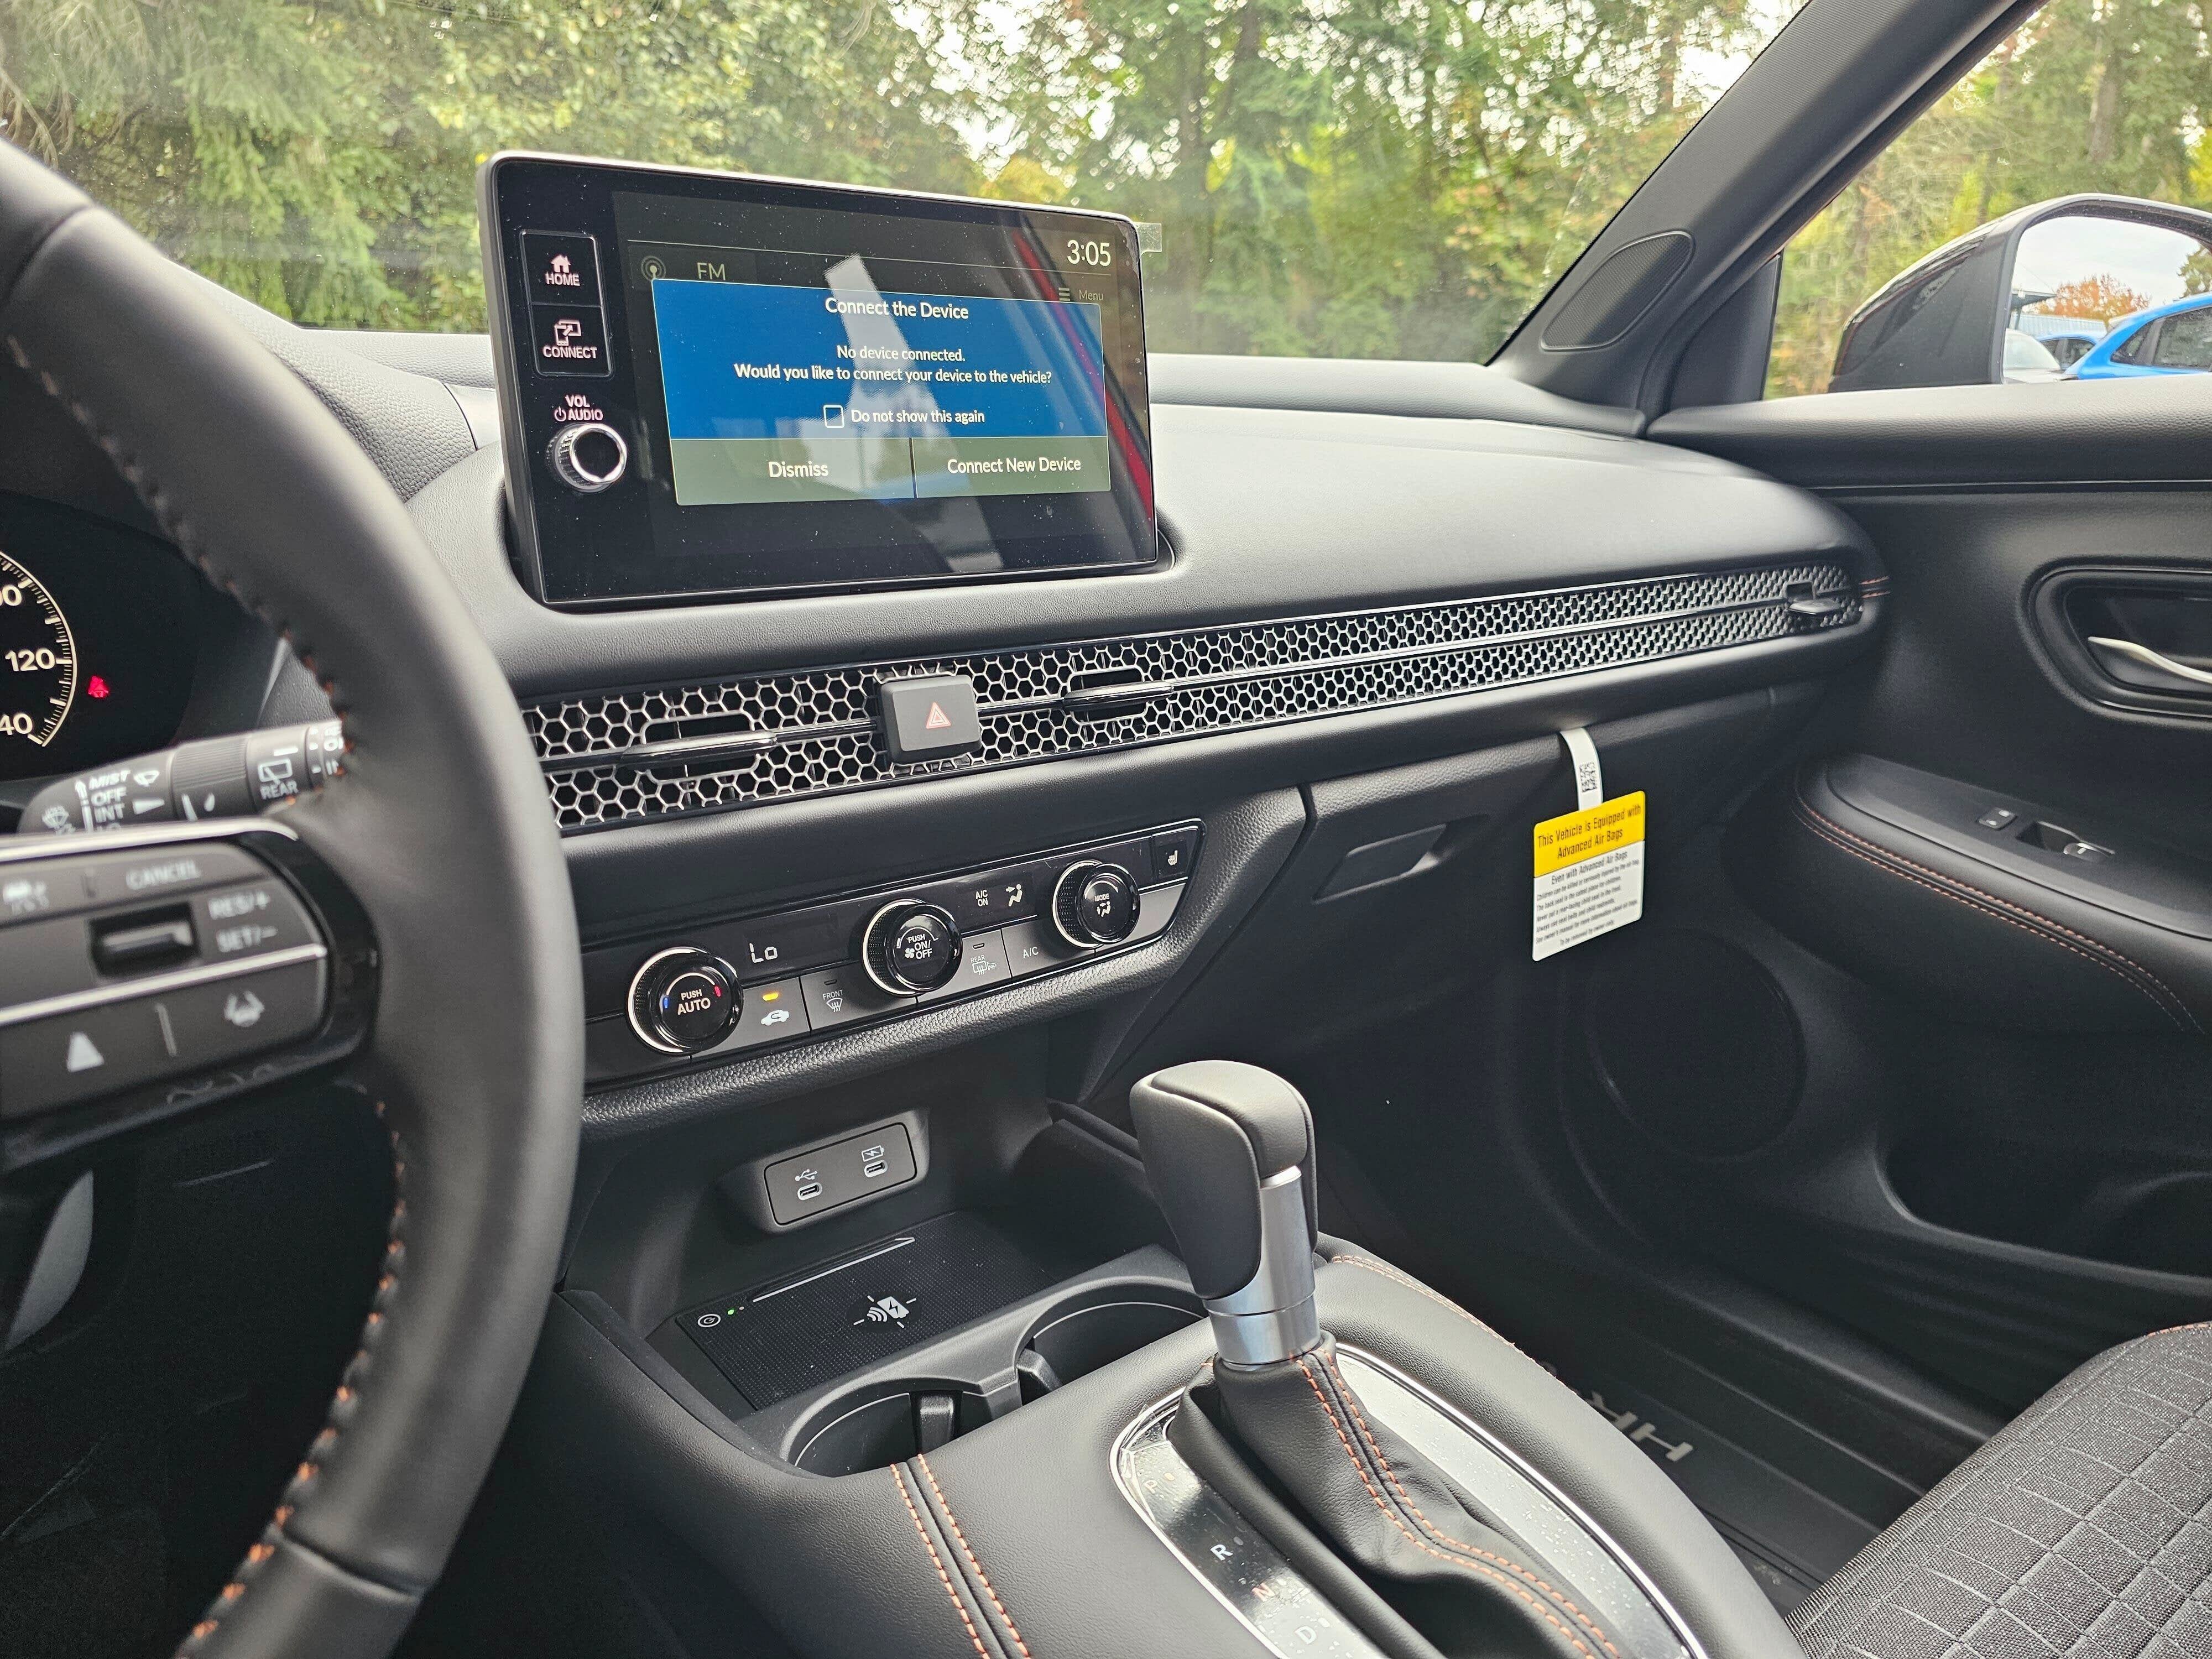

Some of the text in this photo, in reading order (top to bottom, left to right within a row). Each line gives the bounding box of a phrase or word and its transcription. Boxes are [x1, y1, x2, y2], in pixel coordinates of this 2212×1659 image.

[1067, 239, 1112, 267] 3:05
[697, 262, 727, 280] FM
[545, 273, 580, 287] HOME
[1079, 290, 1104, 301] Menu
[825, 298, 969, 319] Connect the Device
[543, 346, 598, 359] CONNECT
[837, 345, 966, 362] No device connected.
[733, 363, 1052, 384] Would you like to connect your device to the vehicle?
[565, 395, 591, 408] VOL
[568, 408, 603, 421] AUDIO
[851, 409, 985, 425] Do not show this again
[768, 460, 829, 478] Dismiss
[947, 456, 1082, 474] Connect New Device
[4, 648, 55, 672] 120
[91, 786, 127, 807] OFF
[259, 780, 299, 800] REAR
[93, 803, 126, 823] INT
[1537, 804, 1641, 848] This Vehicle is Equipped with
[1557, 828, 1623, 859] Advanced Air Bags
[126, 860, 201, 890] CANCEL
[1551, 873, 1565, 885] Even
[1566, 869, 1578, 879] with
[1579, 859, 1605, 874] Advanced
[1615, 852, 1628, 862] Bags
[975, 889, 988, 900] A/C
[977, 898, 989, 907] ON
[1094, 893, 1110, 902] MODE
[907, 933, 926, 943] PUSH
[914, 940, 931, 951] ON/
[749, 942, 778, 964] Lo
[915, 948, 933, 959] OFF
[970, 954, 986, 963] REAR
[1022, 946, 1039, 958] A/C
[680, 988, 703, 1001] PUSH
[822, 989, 844, 1001] FRONT
[677, 998, 711, 1015] AUTO
[1143, 1479, 1159, 1494] P
[1210, 1543, 1234, 1562] R
[1251, 1582, 1275, 1602] N
[1293, 1625, 1318, 1645] D
